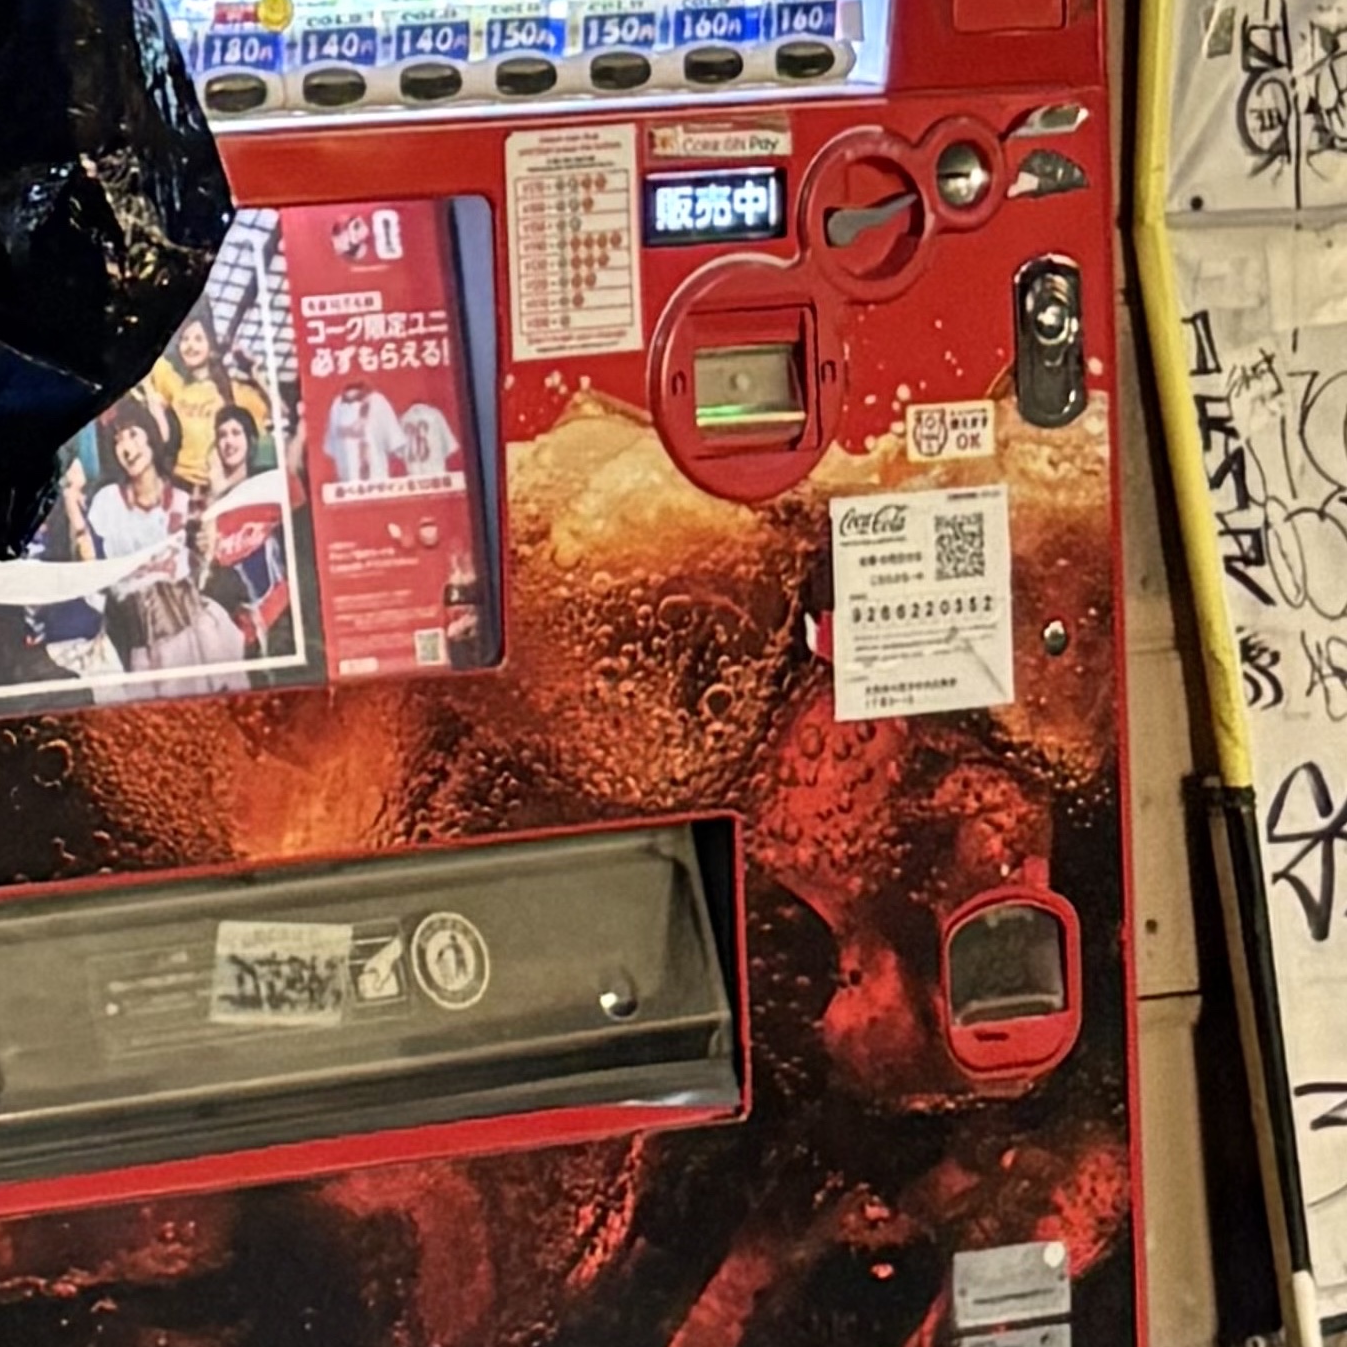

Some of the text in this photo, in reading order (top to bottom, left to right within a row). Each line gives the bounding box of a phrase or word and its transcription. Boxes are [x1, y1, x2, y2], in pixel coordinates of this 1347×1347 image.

[748, 134, 779, 155] Pay
[654, 178, 770, 232] 販売中
[306, 310, 449, 345] コーク限定ユニ
[310, 337, 451, 378] 必ずもらえる!
[956, 433, 982, 451] OK
